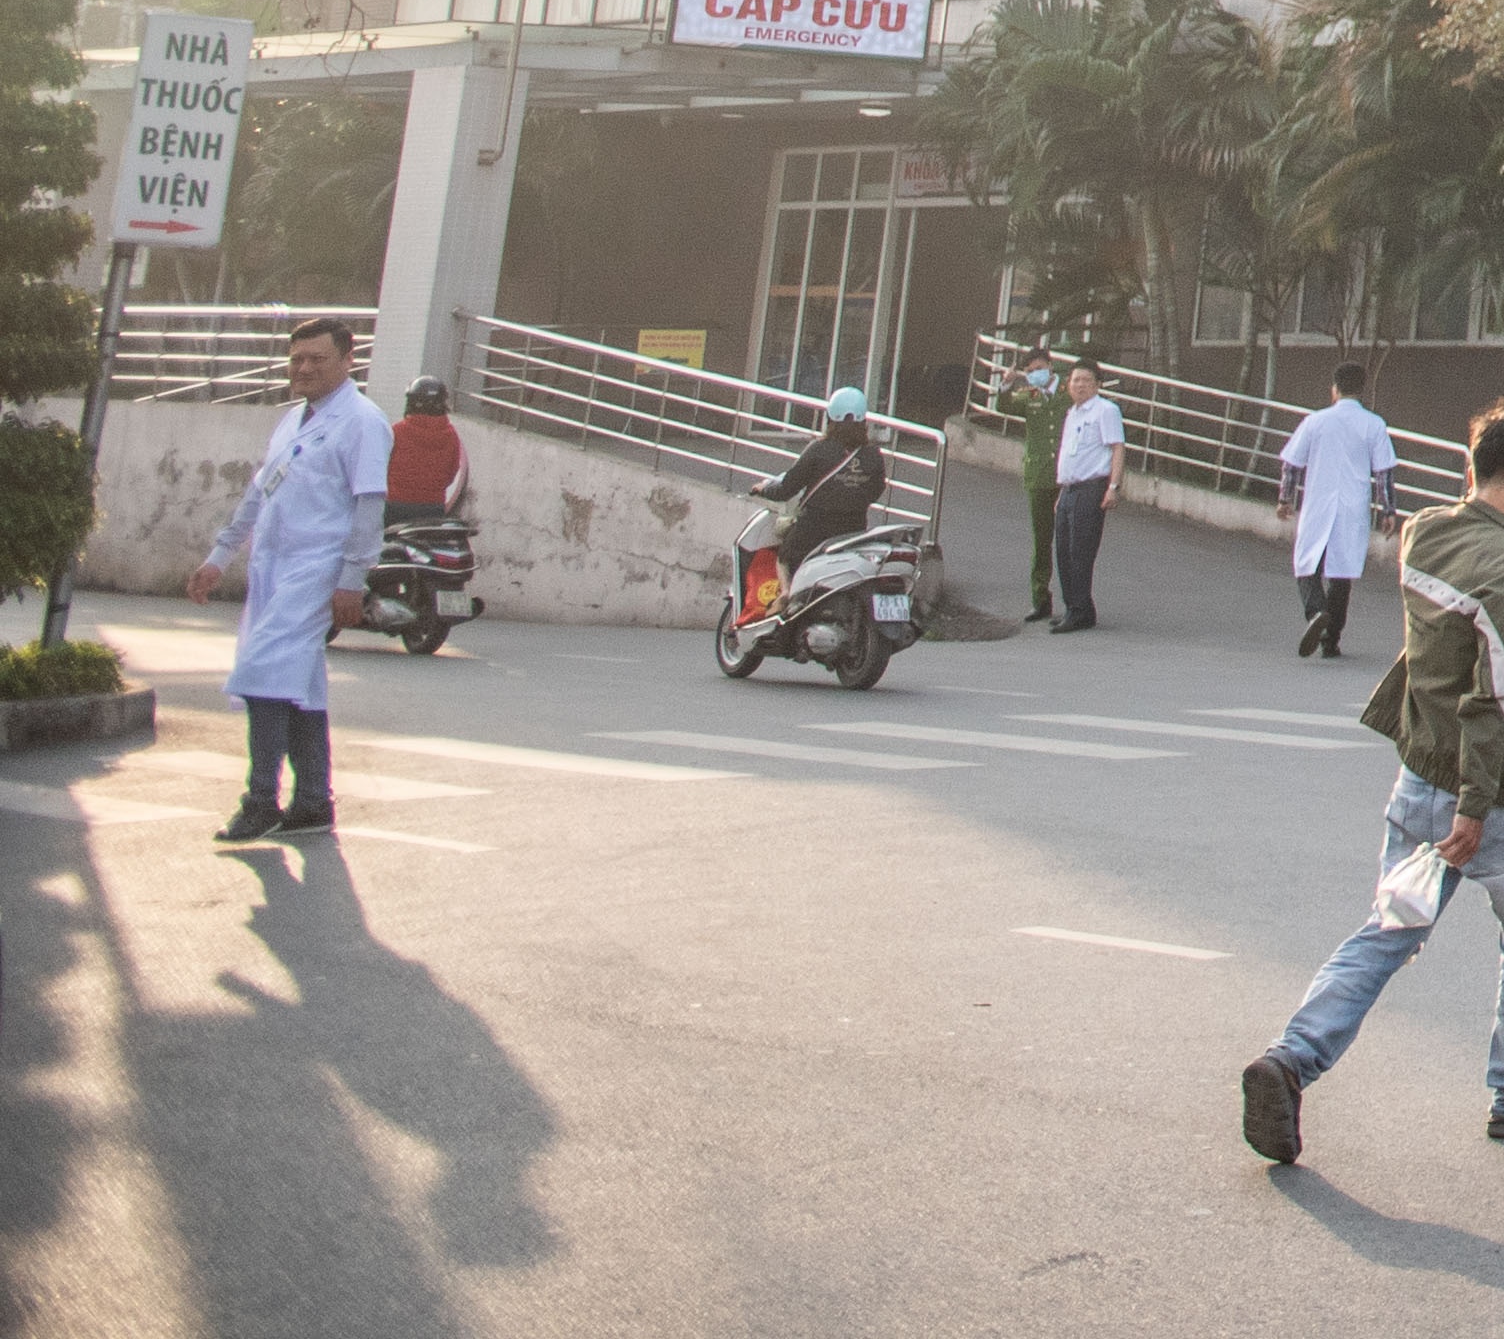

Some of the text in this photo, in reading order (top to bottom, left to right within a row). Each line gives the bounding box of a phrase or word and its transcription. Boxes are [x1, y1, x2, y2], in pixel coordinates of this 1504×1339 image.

[165, 31, 229, 66] NHÀ
[744, 26, 862, 48] EMERGENCY
[140, 76, 242, 115] THUỐC
[139, 123, 224, 165] BỆNH
[138, 172, 210, 214] VIỆN
